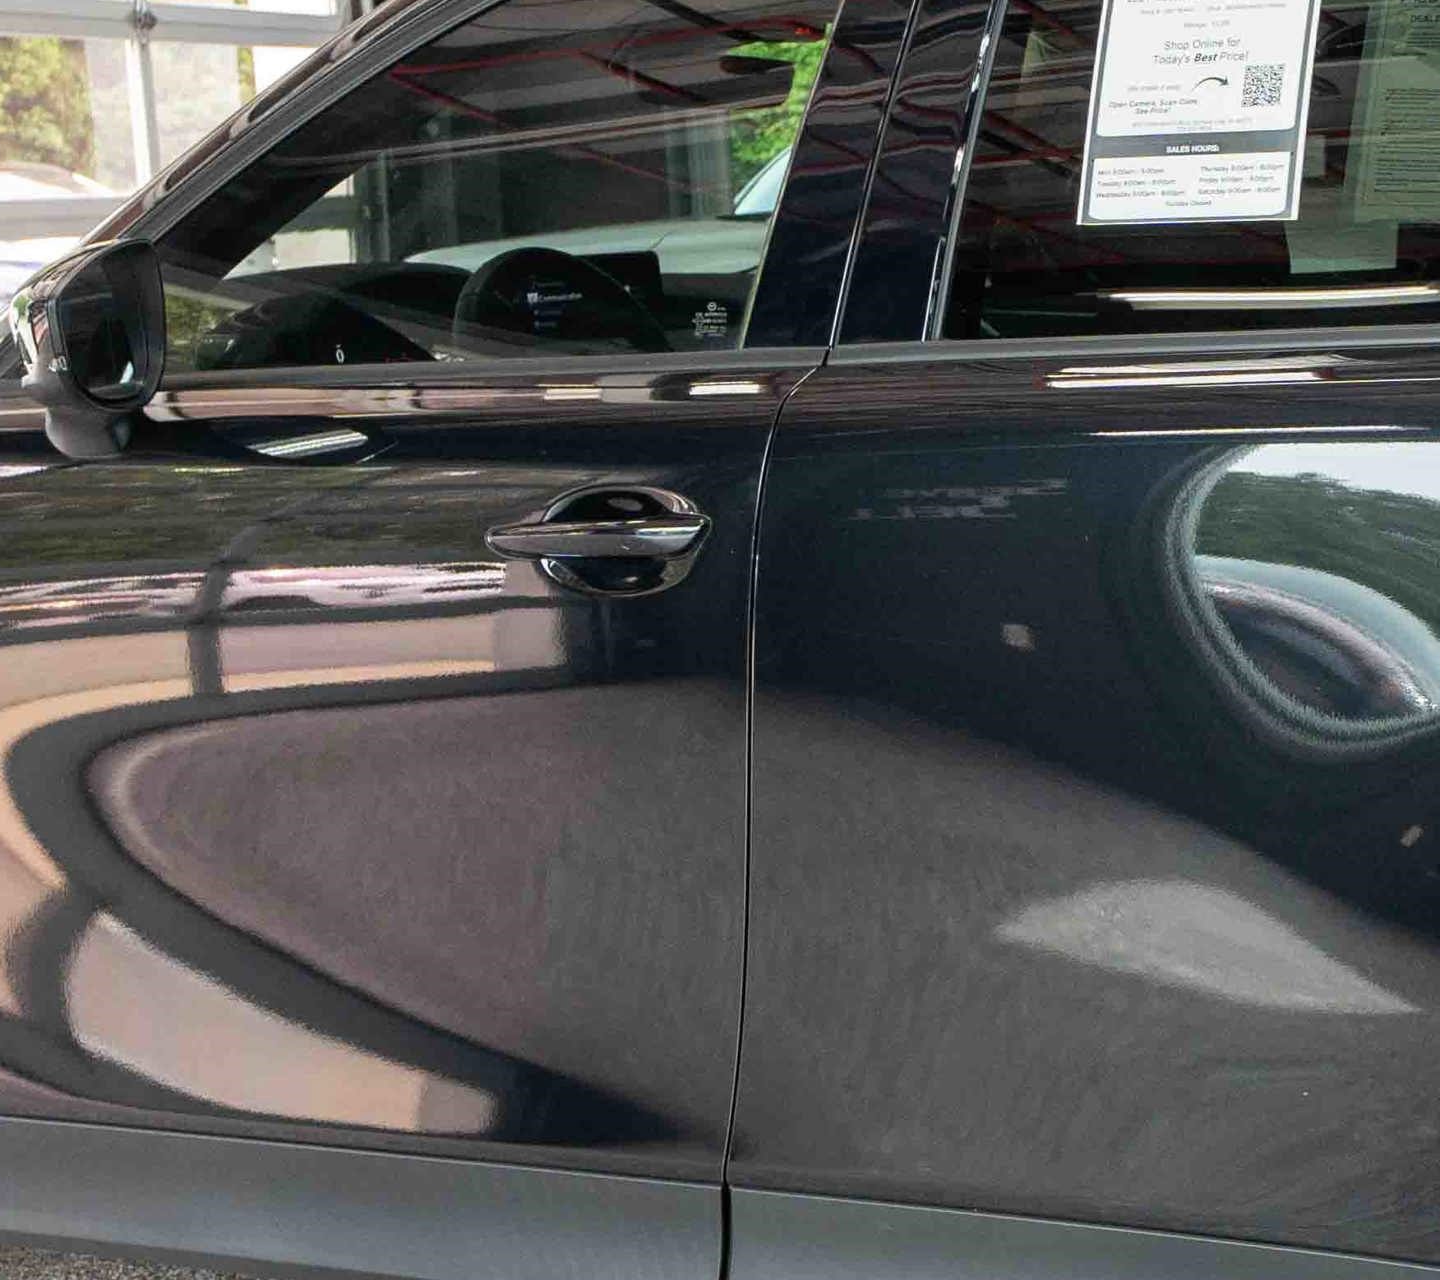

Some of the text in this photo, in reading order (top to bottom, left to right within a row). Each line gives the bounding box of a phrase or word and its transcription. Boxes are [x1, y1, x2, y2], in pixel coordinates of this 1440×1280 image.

[1164, 37, 1241, 51] Shop Online for
[1153, 51, 1249, 67] Today's Best Price!
[1165, 145, 1190, 154] SALES
